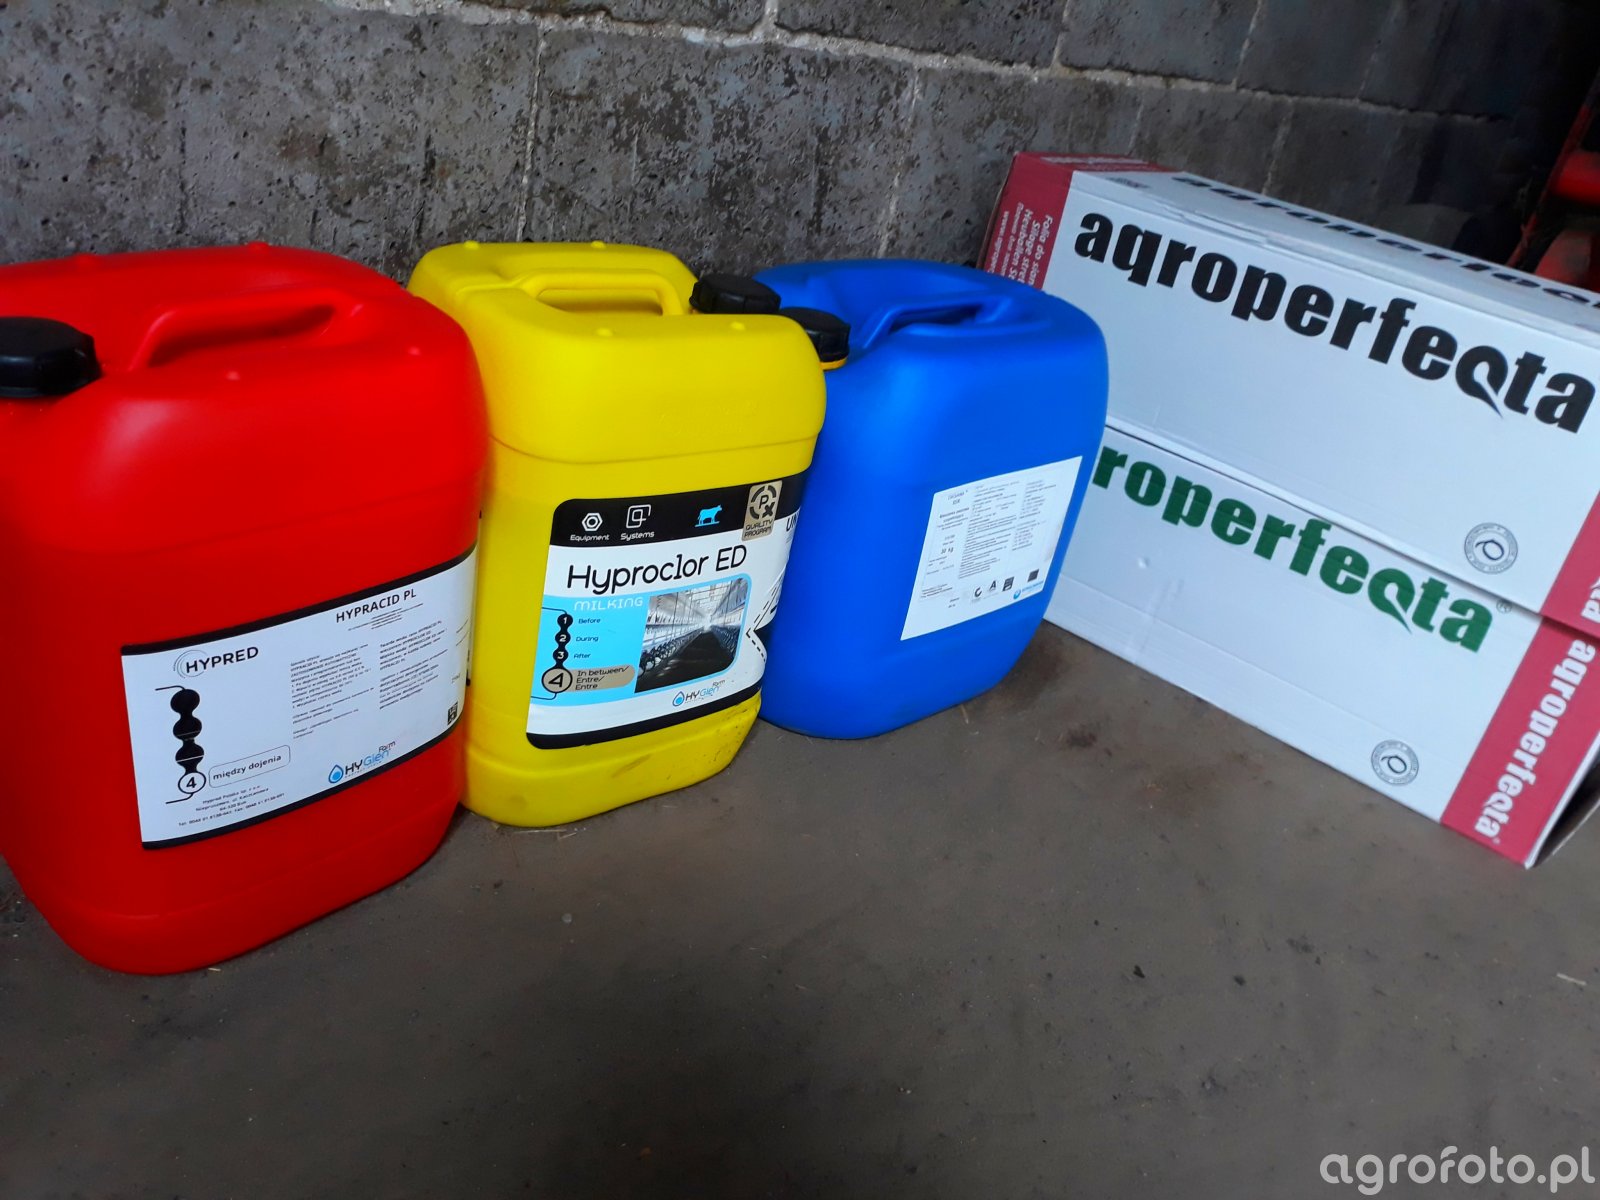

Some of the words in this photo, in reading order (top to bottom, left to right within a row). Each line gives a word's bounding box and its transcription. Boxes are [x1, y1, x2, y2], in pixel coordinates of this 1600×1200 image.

[745, 519, 773, 531] QUALITY
[569, 534, 610, 542] Equipment
[620, 531, 655, 542] Systems
[744, 526, 772, 538] PROGRAM
[567, 554, 709, 595] Hyproclor
[715, 544, 748, 572] ED
[335, 594, 400, 623] HYPRACID
[403, 588, 417, 601] PL
[573, 597, 644, 611] MILKING
[563, 616, 568, 624] 1
[559, 634, 567, 642] 2
[186, 646, 259, 674] HYPRED
[557, 651, 565, 659] 3
[548, 672, 564, 688] 4
[186, 776, 197, 789] 4
[213, 766, 247, 780] między
[248, 755, 282, 771] dojenia
